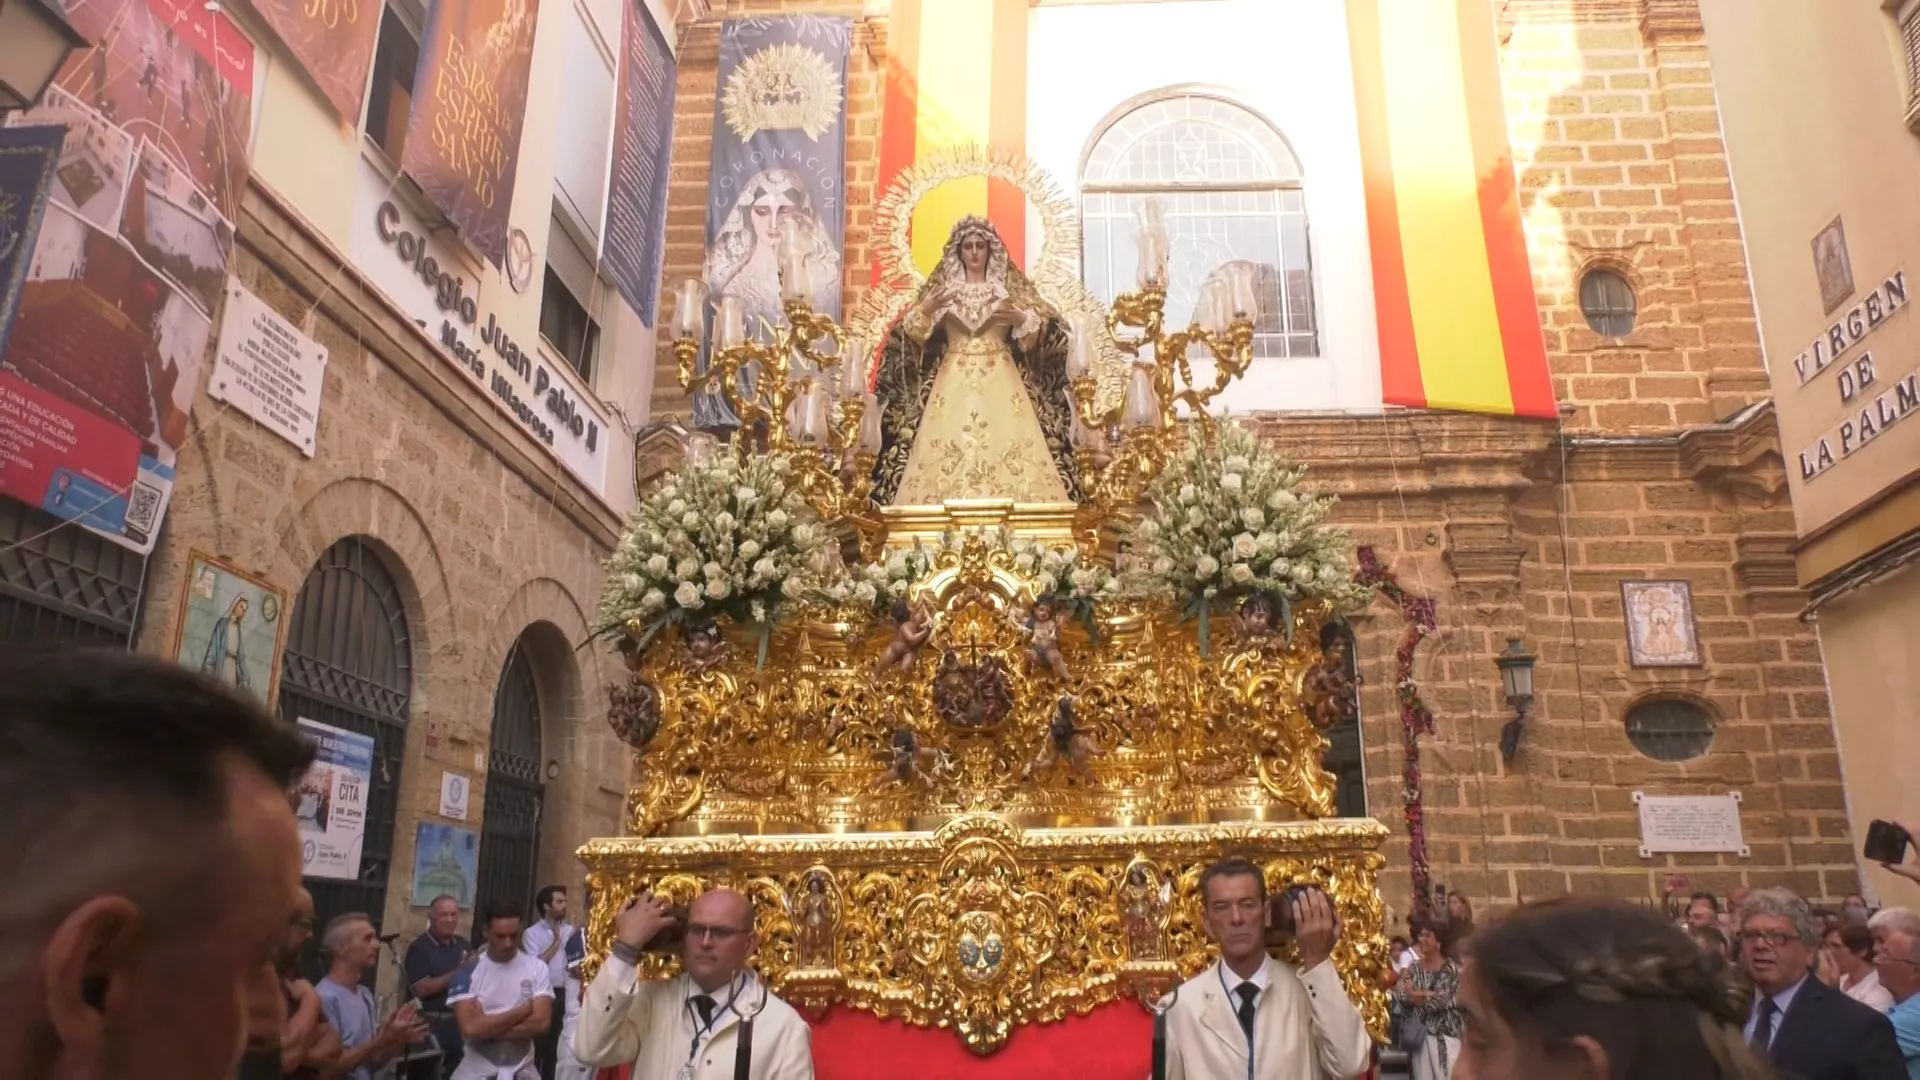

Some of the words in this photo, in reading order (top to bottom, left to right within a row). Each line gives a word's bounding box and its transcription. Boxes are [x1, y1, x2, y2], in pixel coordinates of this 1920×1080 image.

[446, 31, 499, 126] ESPOSA
[432, 112, 494, 209] SANTO
[377, 200, 477, 324] Colegio
[480, 312, 532, 384] Juan
[532, 364, 584, 437] Pablo
[1793, 270, 1906, 384] VIRGEN
[7, 390, 25, 406] UNA
[26, 398, 75, 431] EDUCACIÓN
[441, 318, 485, 381] María
[490, 368, 554, 446] Milagrosa
[1837, 353, 1875, 402] DE
[42, 421, 77, 445] CALIDAD
[1799, 438, 1833, 481] LA
[1839, 374, 1920, 455] PALM
[339, 783, 359, 803] CITA
